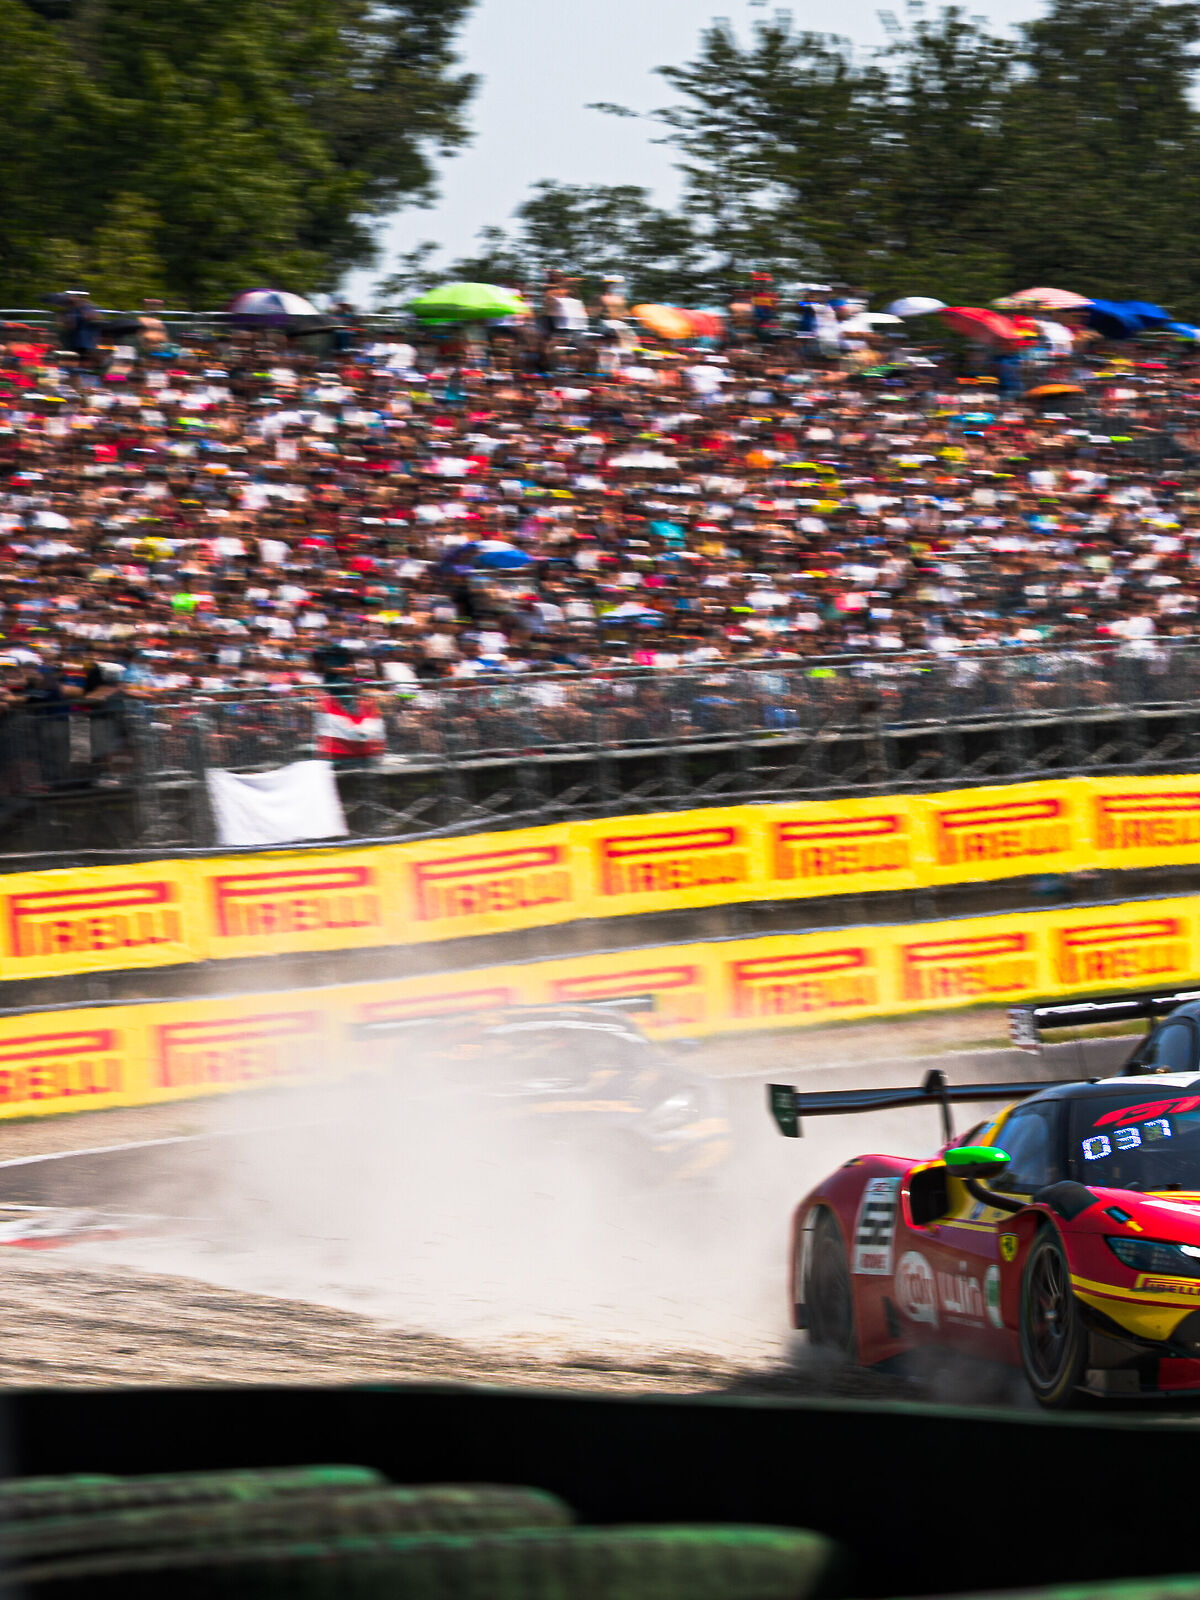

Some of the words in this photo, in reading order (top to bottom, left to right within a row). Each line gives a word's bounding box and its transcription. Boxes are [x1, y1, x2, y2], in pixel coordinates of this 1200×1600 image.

[596, 826, 748, 895] PIRELLI
[772, 814, 910, 880] PIRELLI
[934, 798, 1072, 866] PIRELLI
[208, 865, 382, 937] PIRELLI
[410, 845, 571, 920] PIRELLI
[6, 880, 182, 957] PIRELLI
[1054, 918, 1188, 984] PIRELLI
[731, 947, 876, 1017] PIRELLI
[901, 932, 1037, 1000] PIRELLI
[0, 1029, 123, 1102] PRELLI
[154, 1009, 326, 1088] PIRE
[1081, 1118, 1173, 1161] 037
